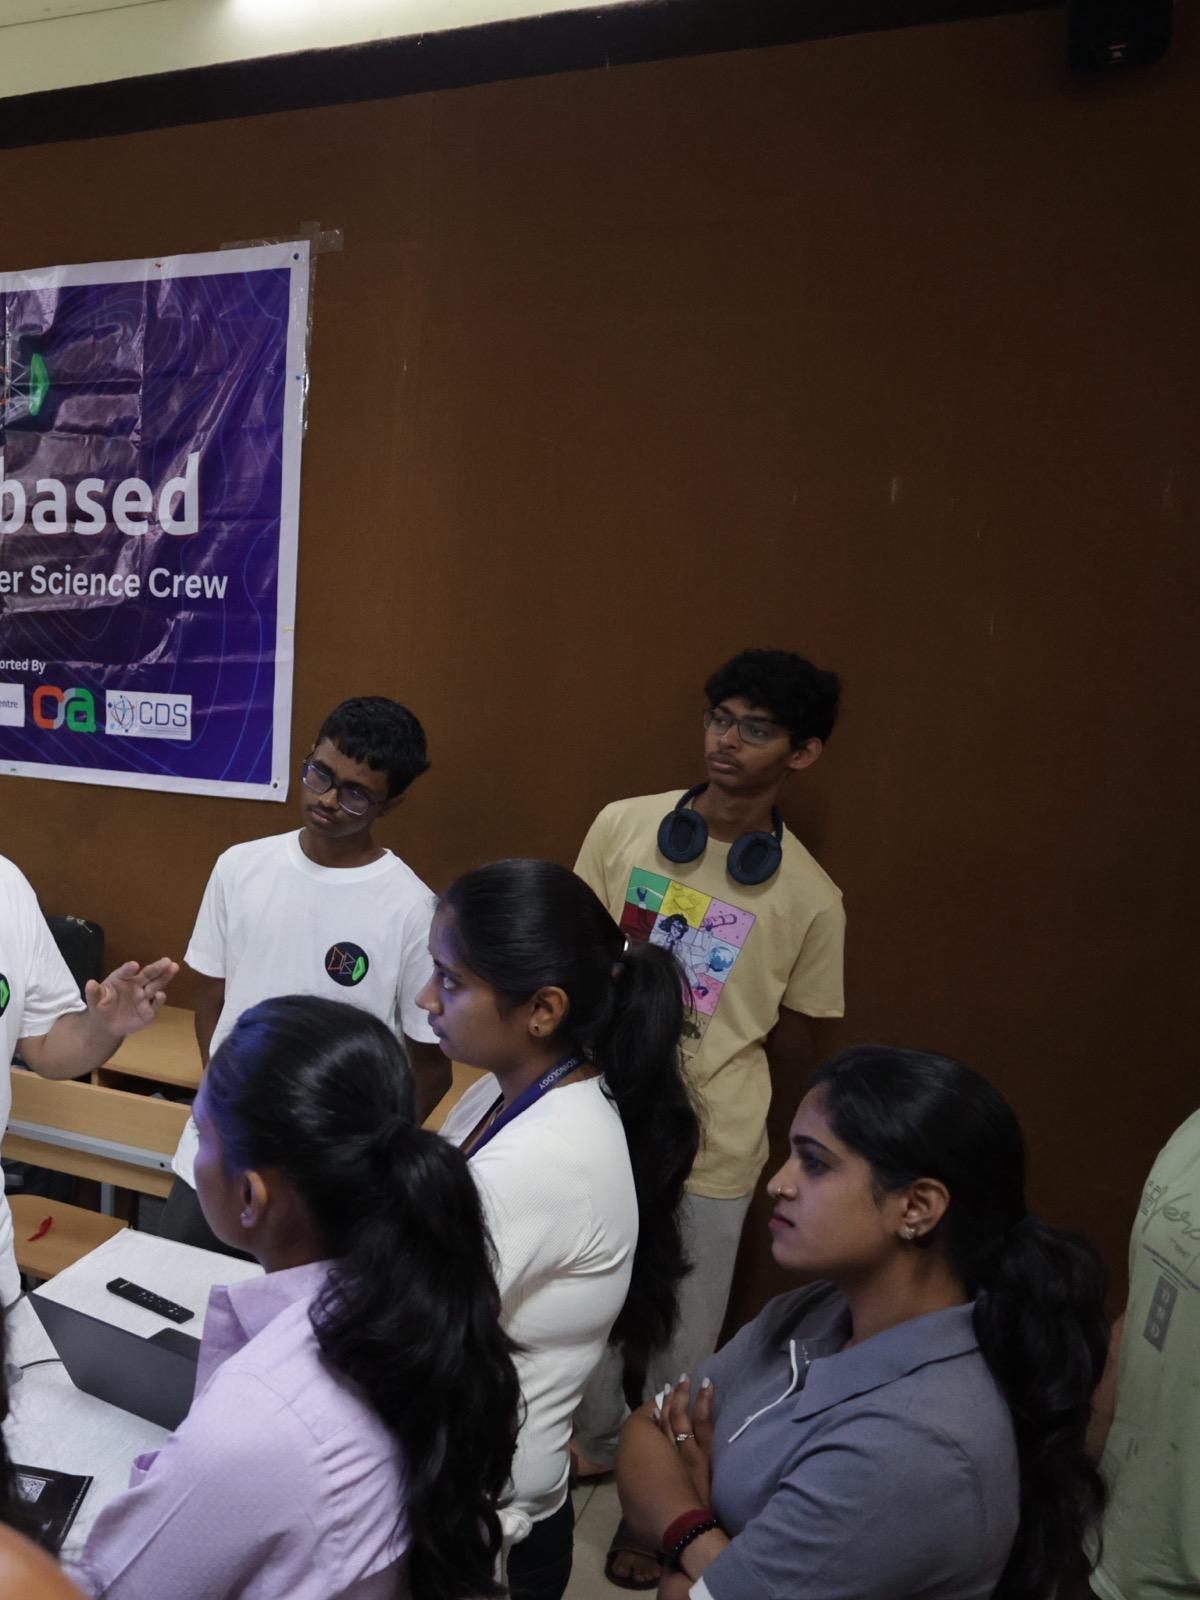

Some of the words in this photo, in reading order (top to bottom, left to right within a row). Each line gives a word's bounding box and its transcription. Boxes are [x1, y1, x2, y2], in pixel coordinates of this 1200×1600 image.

[31, 564, 140, 598] Science
[148, 568, 228, 599] Crew
[32, 659, 46, 675] By
[139, 701, 188, 727] CDS
